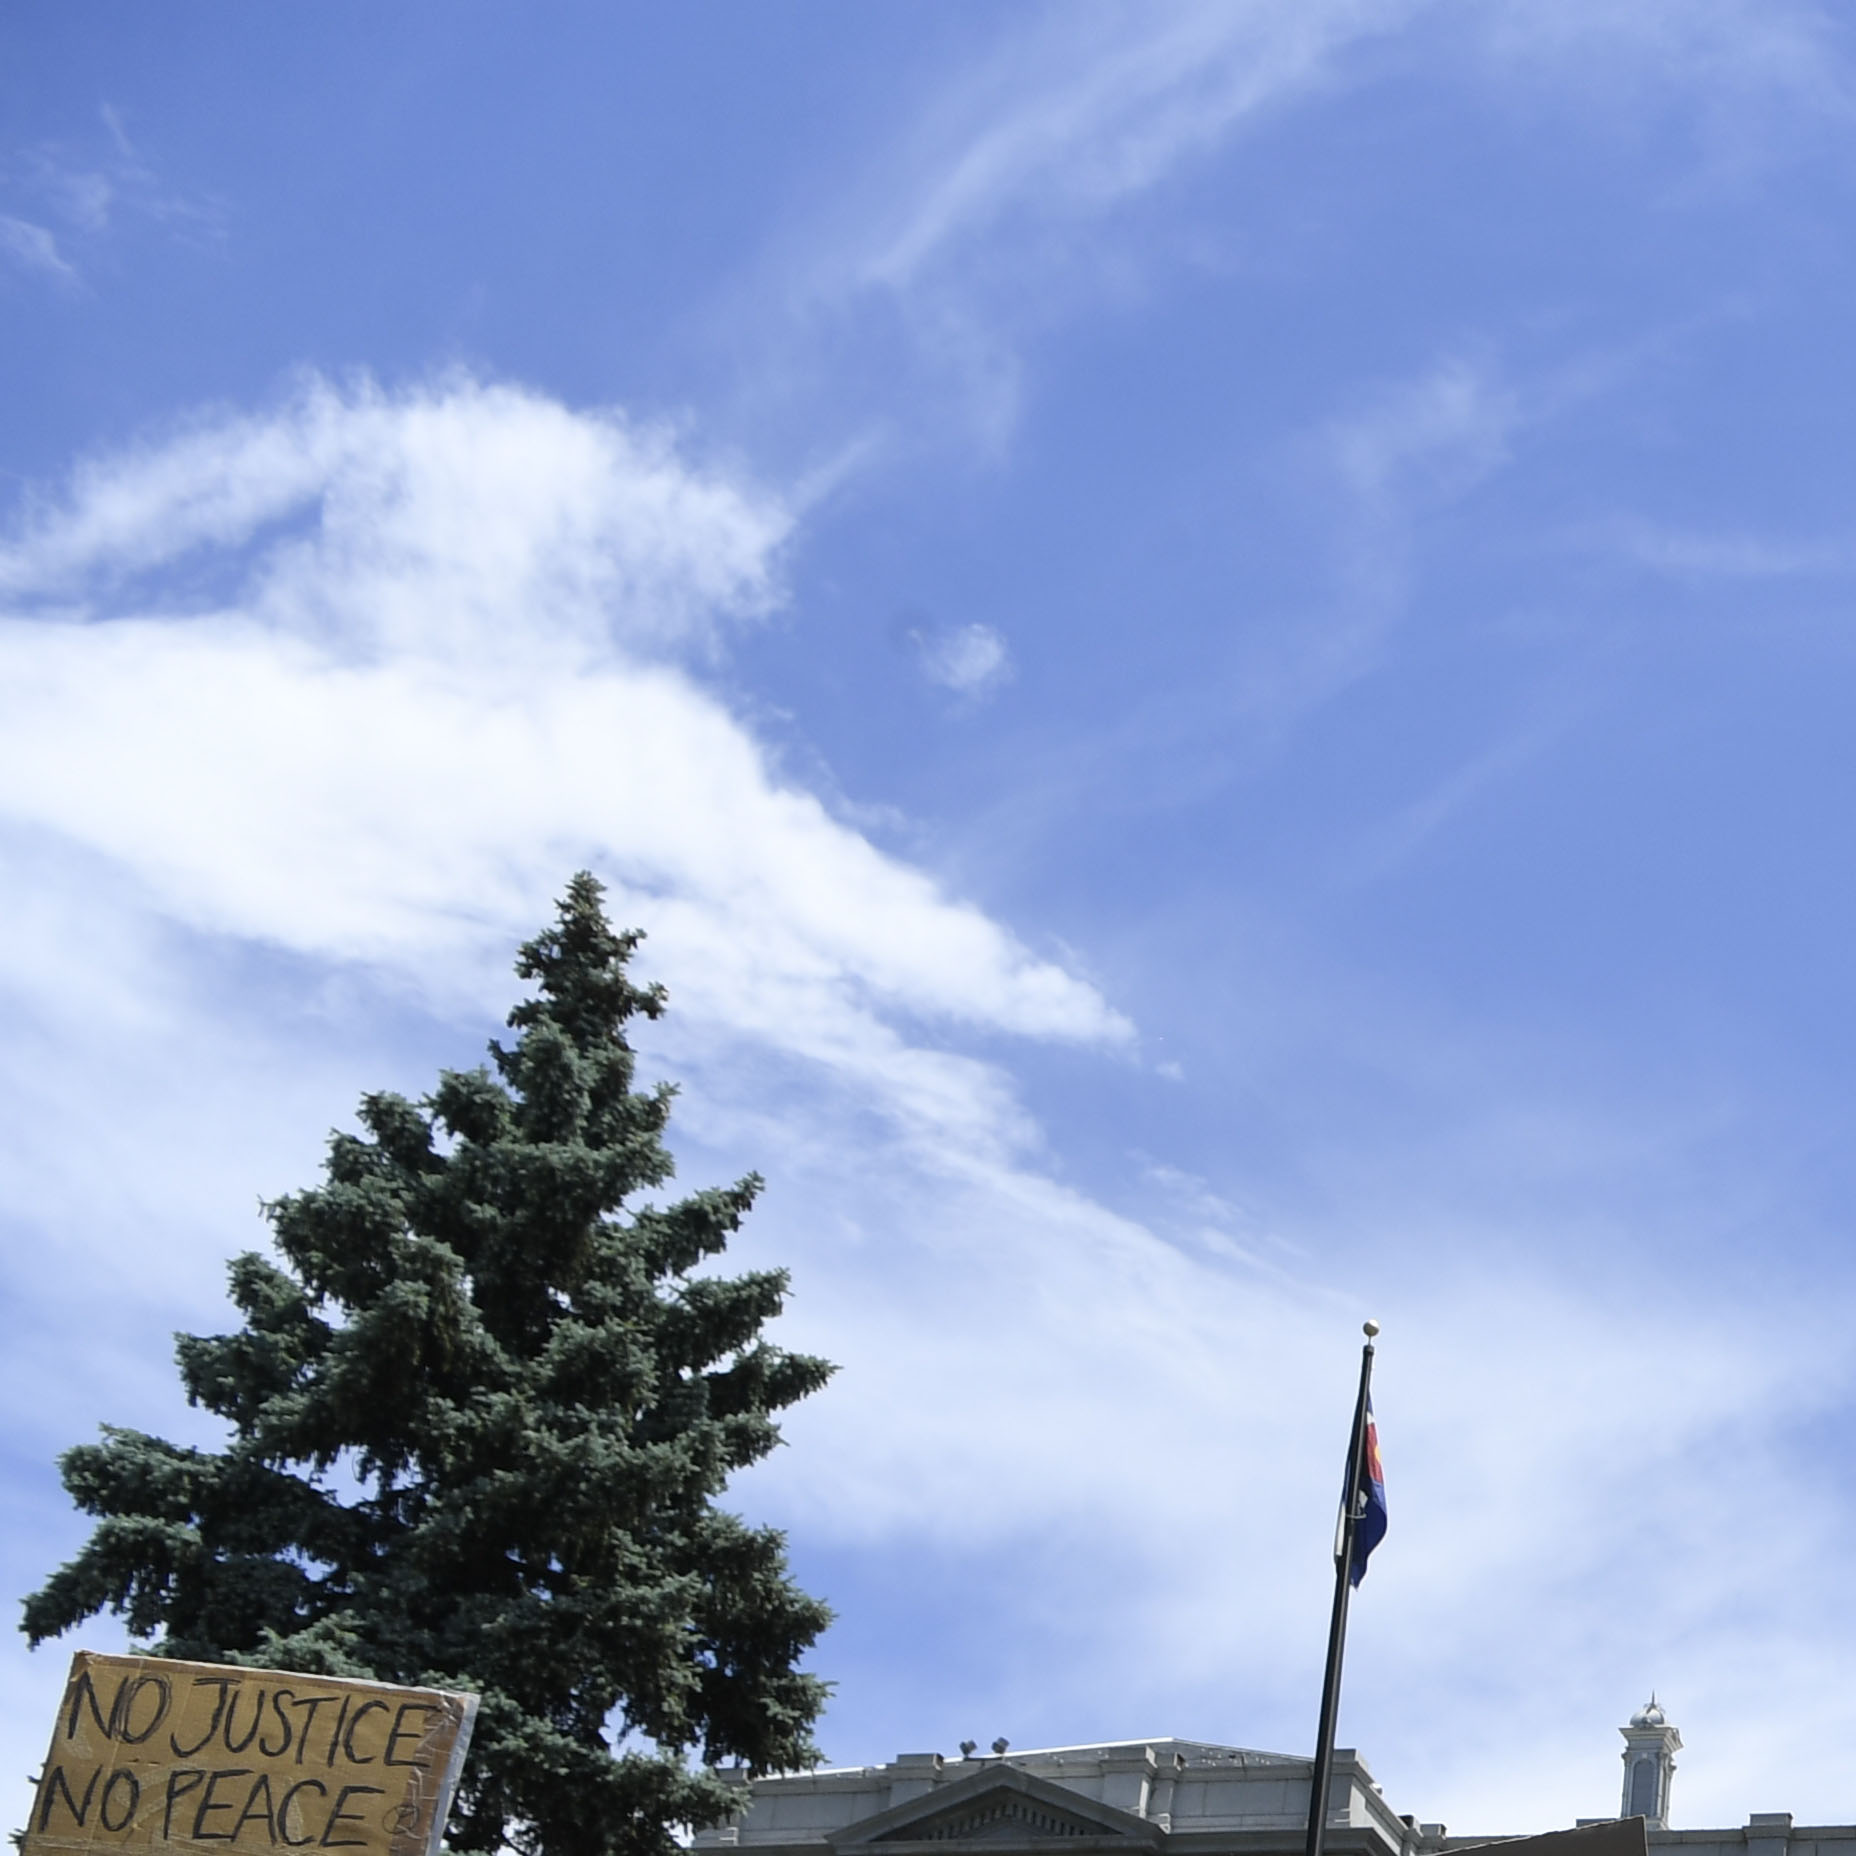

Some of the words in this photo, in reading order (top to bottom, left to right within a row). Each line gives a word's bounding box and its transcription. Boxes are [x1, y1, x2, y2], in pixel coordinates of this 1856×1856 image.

[67, 1670, 171, 1746] NO
[171, 1677, 442, 1767] JUSTICE
[40, 1763, 141, 1834] NO
[165, 1769, 385, 1848] PEACE
